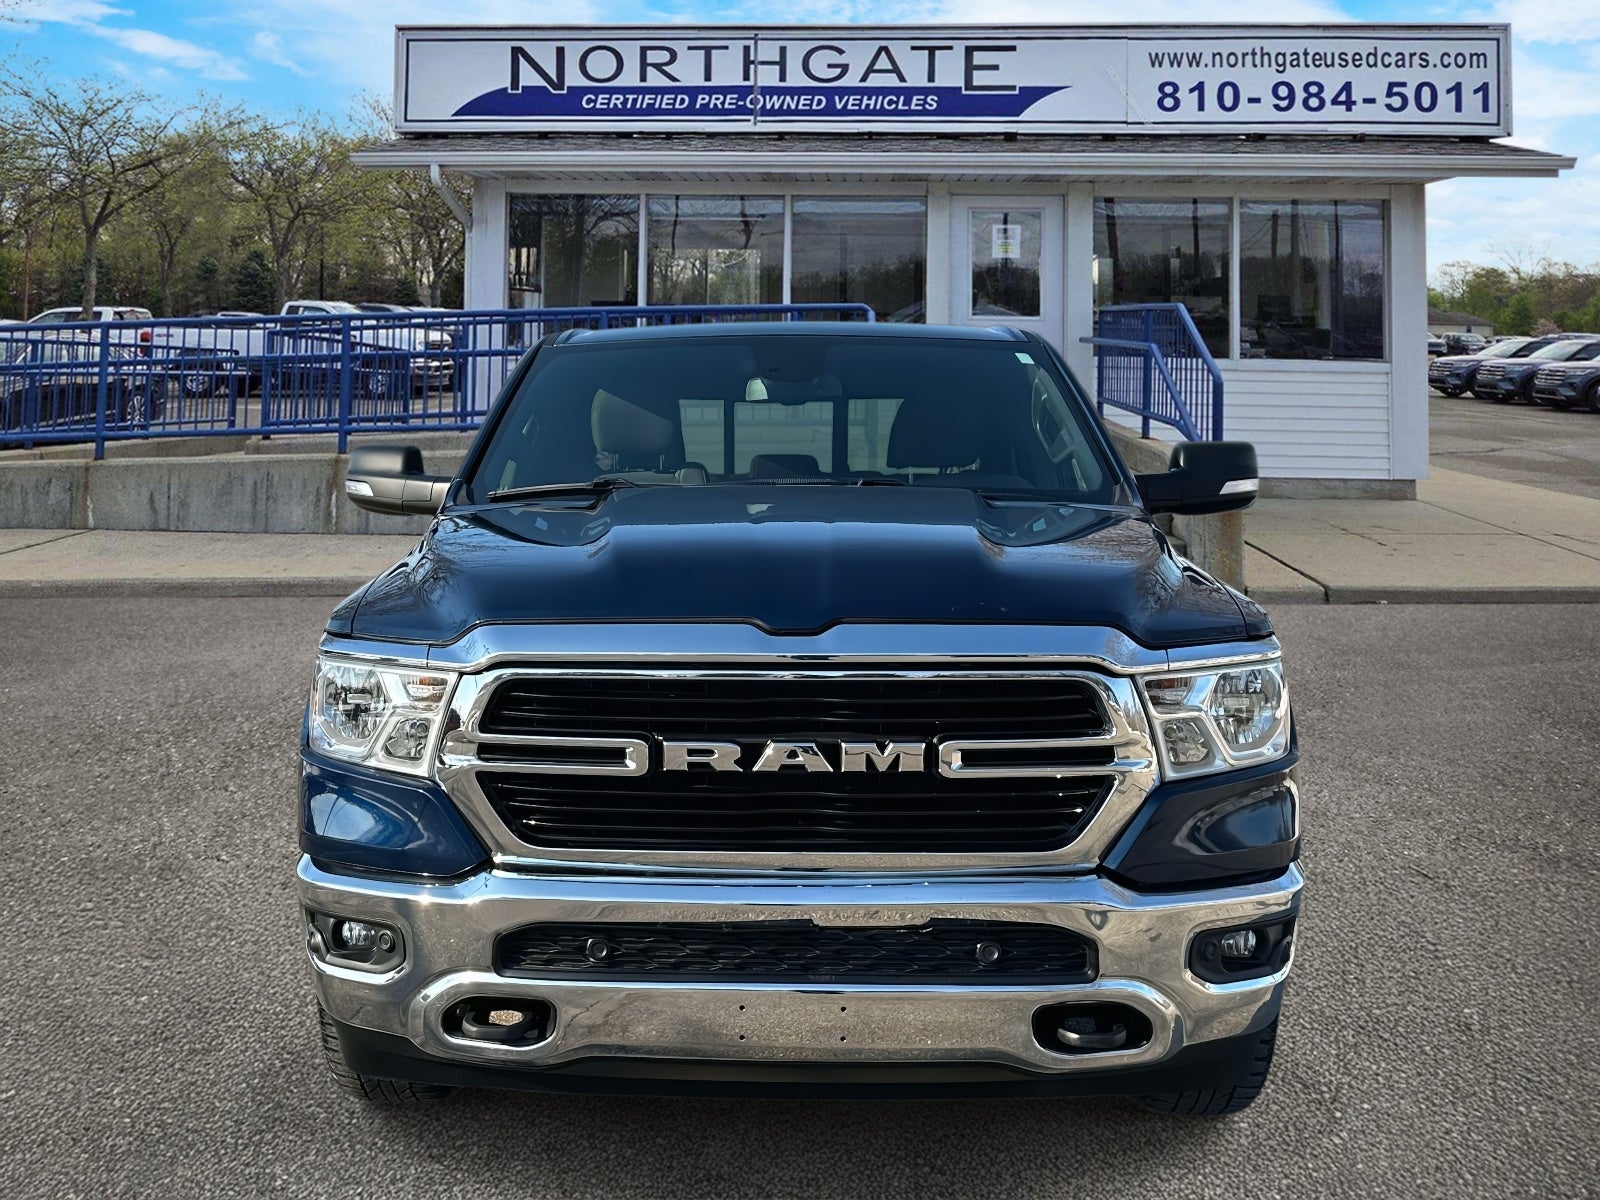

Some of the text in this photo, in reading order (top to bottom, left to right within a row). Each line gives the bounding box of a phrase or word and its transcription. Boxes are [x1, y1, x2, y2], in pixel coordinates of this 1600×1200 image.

[510, 45, 1017, 92] NORTHGATE
[1148, 46, 1489, 73] www.northgateusedcars.com
[581, 94, 938, 110] CERTIFIED PRE-OWNED VEHICLES
[1156, 80, 1491, 113] 810-984-5011
[662, 740, 926, 772] RAM
